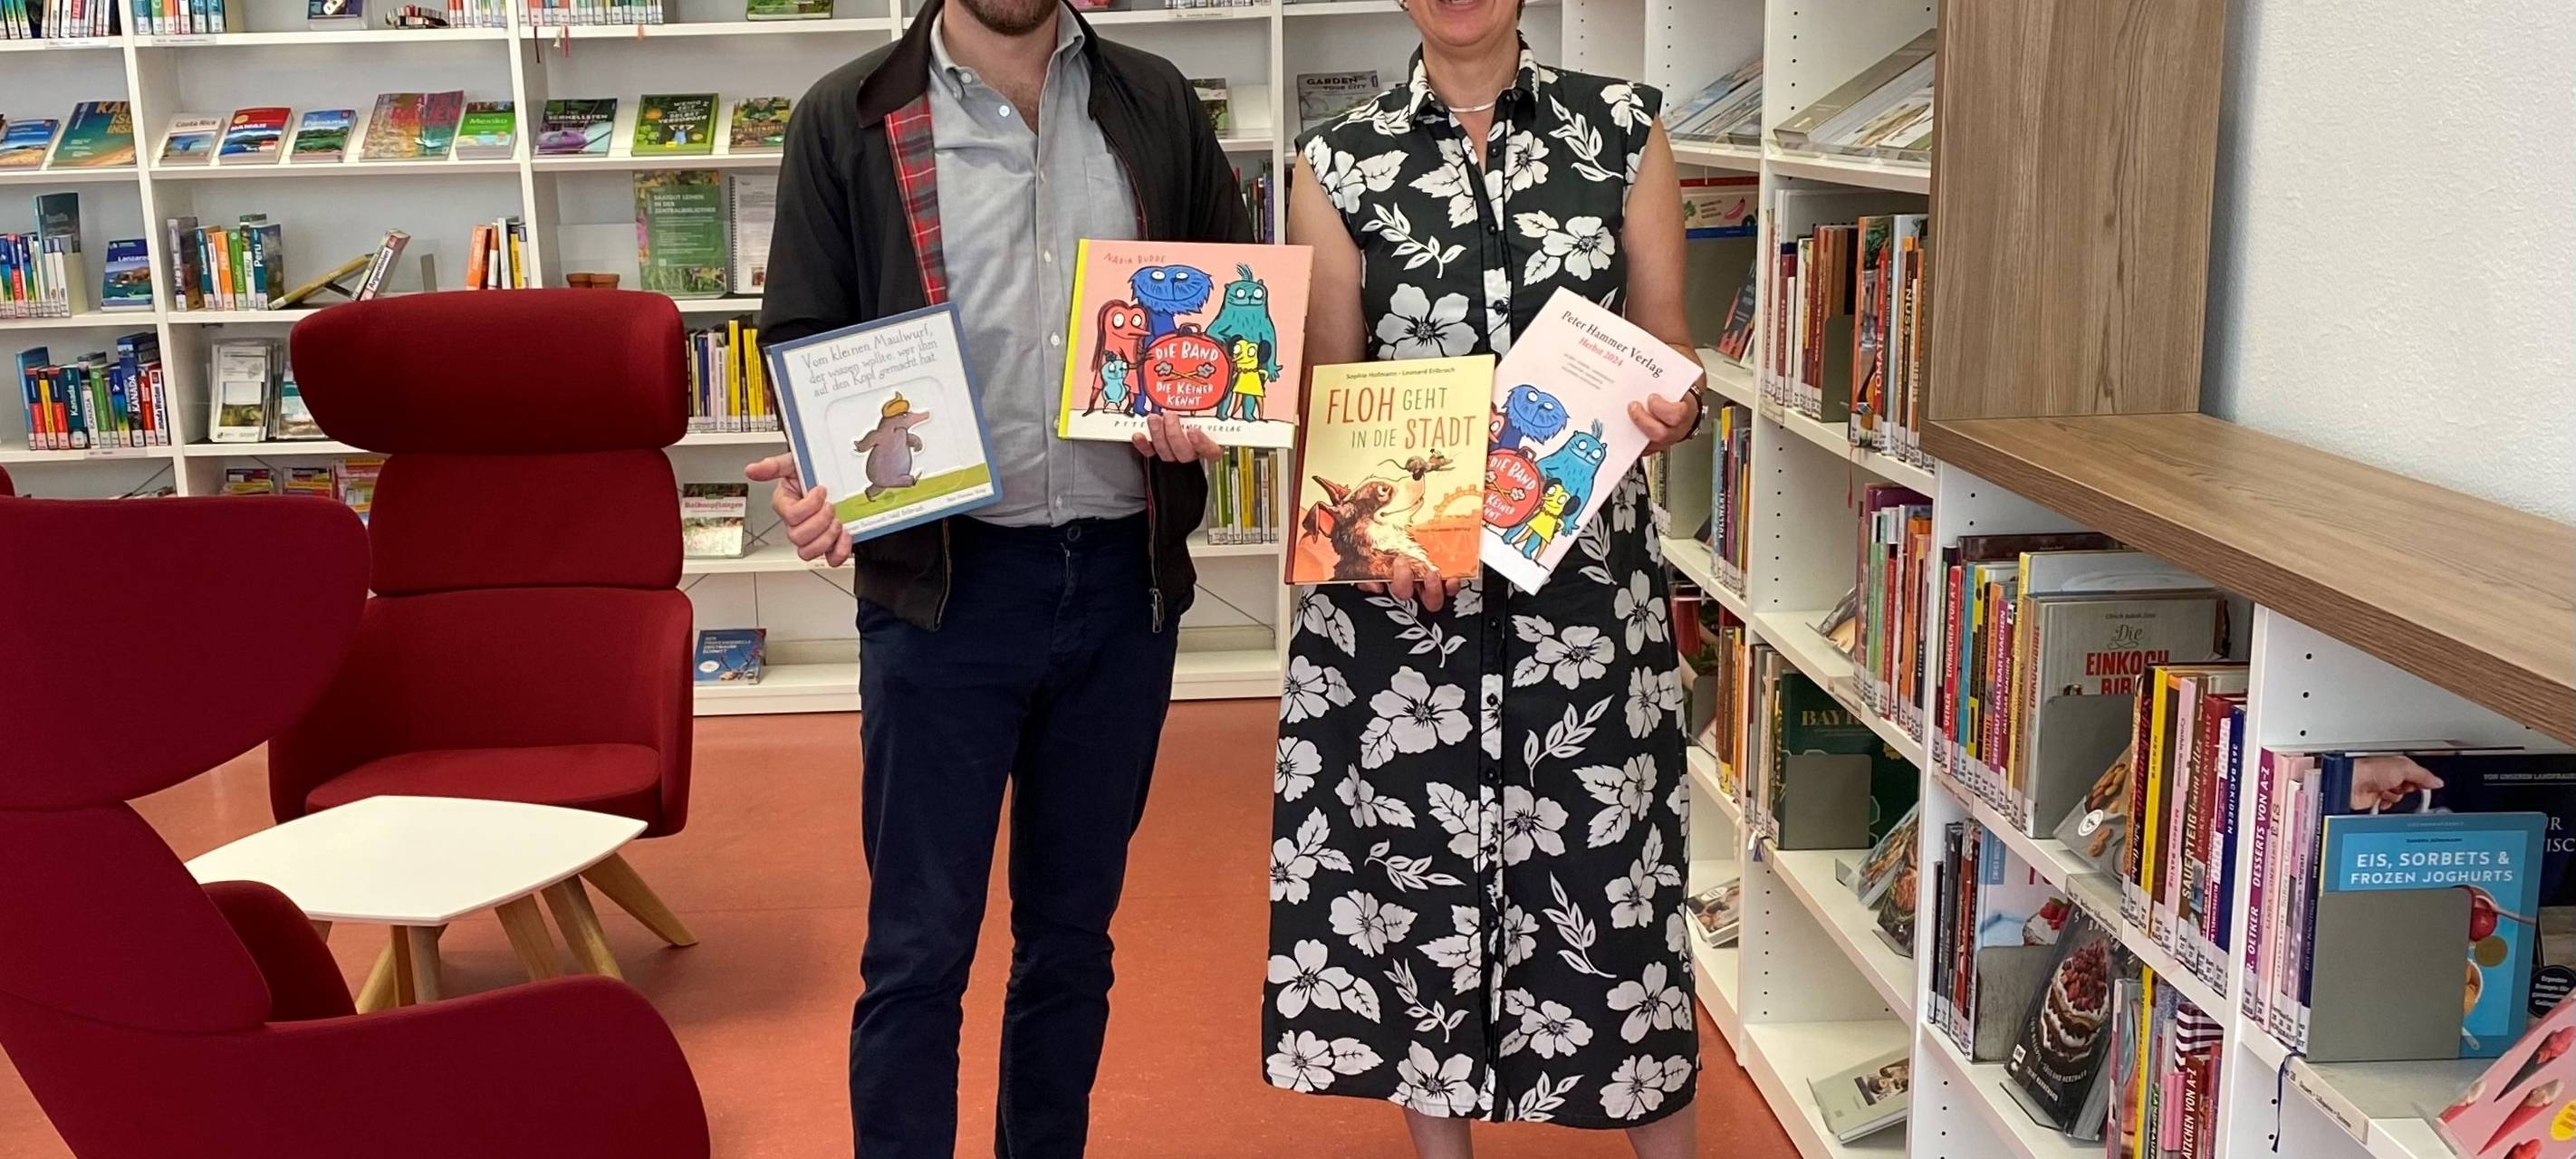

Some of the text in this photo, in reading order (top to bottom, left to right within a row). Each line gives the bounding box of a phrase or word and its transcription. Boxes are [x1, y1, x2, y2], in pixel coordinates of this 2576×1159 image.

[1307, 76, 1358, 86] GARDEN
[254, 244, 264, 267] Peru
[367, 248, 392, 291] Argentinien
[1904, 288, 1912, 335] NUSS
[802, 353, 830, 369] Vom
[831, 340, 871, 360] kleinen
[1155, 341, 1219, 361] DIE BAND
[1561, 310, 1588, 330] Peter
[1585, 324, 1629, 353] Hammer
[1628, 348, 1665, 378] Verlag
[1578, 336, 1624, 368] Herbst 2024
[809, 369, 826, 384] der
[898, 346, 915, 359] wer
[918, 340, 938, 352] ihm
[814, 353, 937, 398] auf den Kopf gemacht hat
[1874, 332, 1884, 396] TOMATE
[67, 385, 78, 417] Kanada
[128, 375, 140, 413] KANADA
[1156, 381, 1214, 395] DIE KEINER
[1166, 395, 1202, 407] KENNT
[86, 398, 95, 429] KANADA
[1327, 388, 1447, 424] FLOH GEHT
[1351, 416, 1476, 449] IN DIE STADT
[1490, 456, 1536, 491] DIE BAND
[1948, 581, 1956, 599] A-Z
[1947, 601, 1956, 621] VON
[1946, 625, 1956, 677] EINMACHEN
[1992, 608, 2006, 765] SEHR GUT HALTBAR MACHEN
[2101, 677, 2132, 694] BIB
[2227, 767, 2237, 835] BACKIDEEN
[2181, 814, 2197, 898] SAUERTEIG
[2191, 738, 2203, 773] alles
[2271, 802, 2280, 838] EIS
[2168, 853, 2178, 889] Baking
[2247, 765, 2270, 954] OETKER DESSERTS VON A-Z
[2357, 851, 2509, 869] EIS, SORBETS &
[2350, 870, 2514, 886] FROZEN JOGHURTS
[2187, 1068, 2197, 1087] A-Z
[2184, 1089, 2196, 1112] VON
